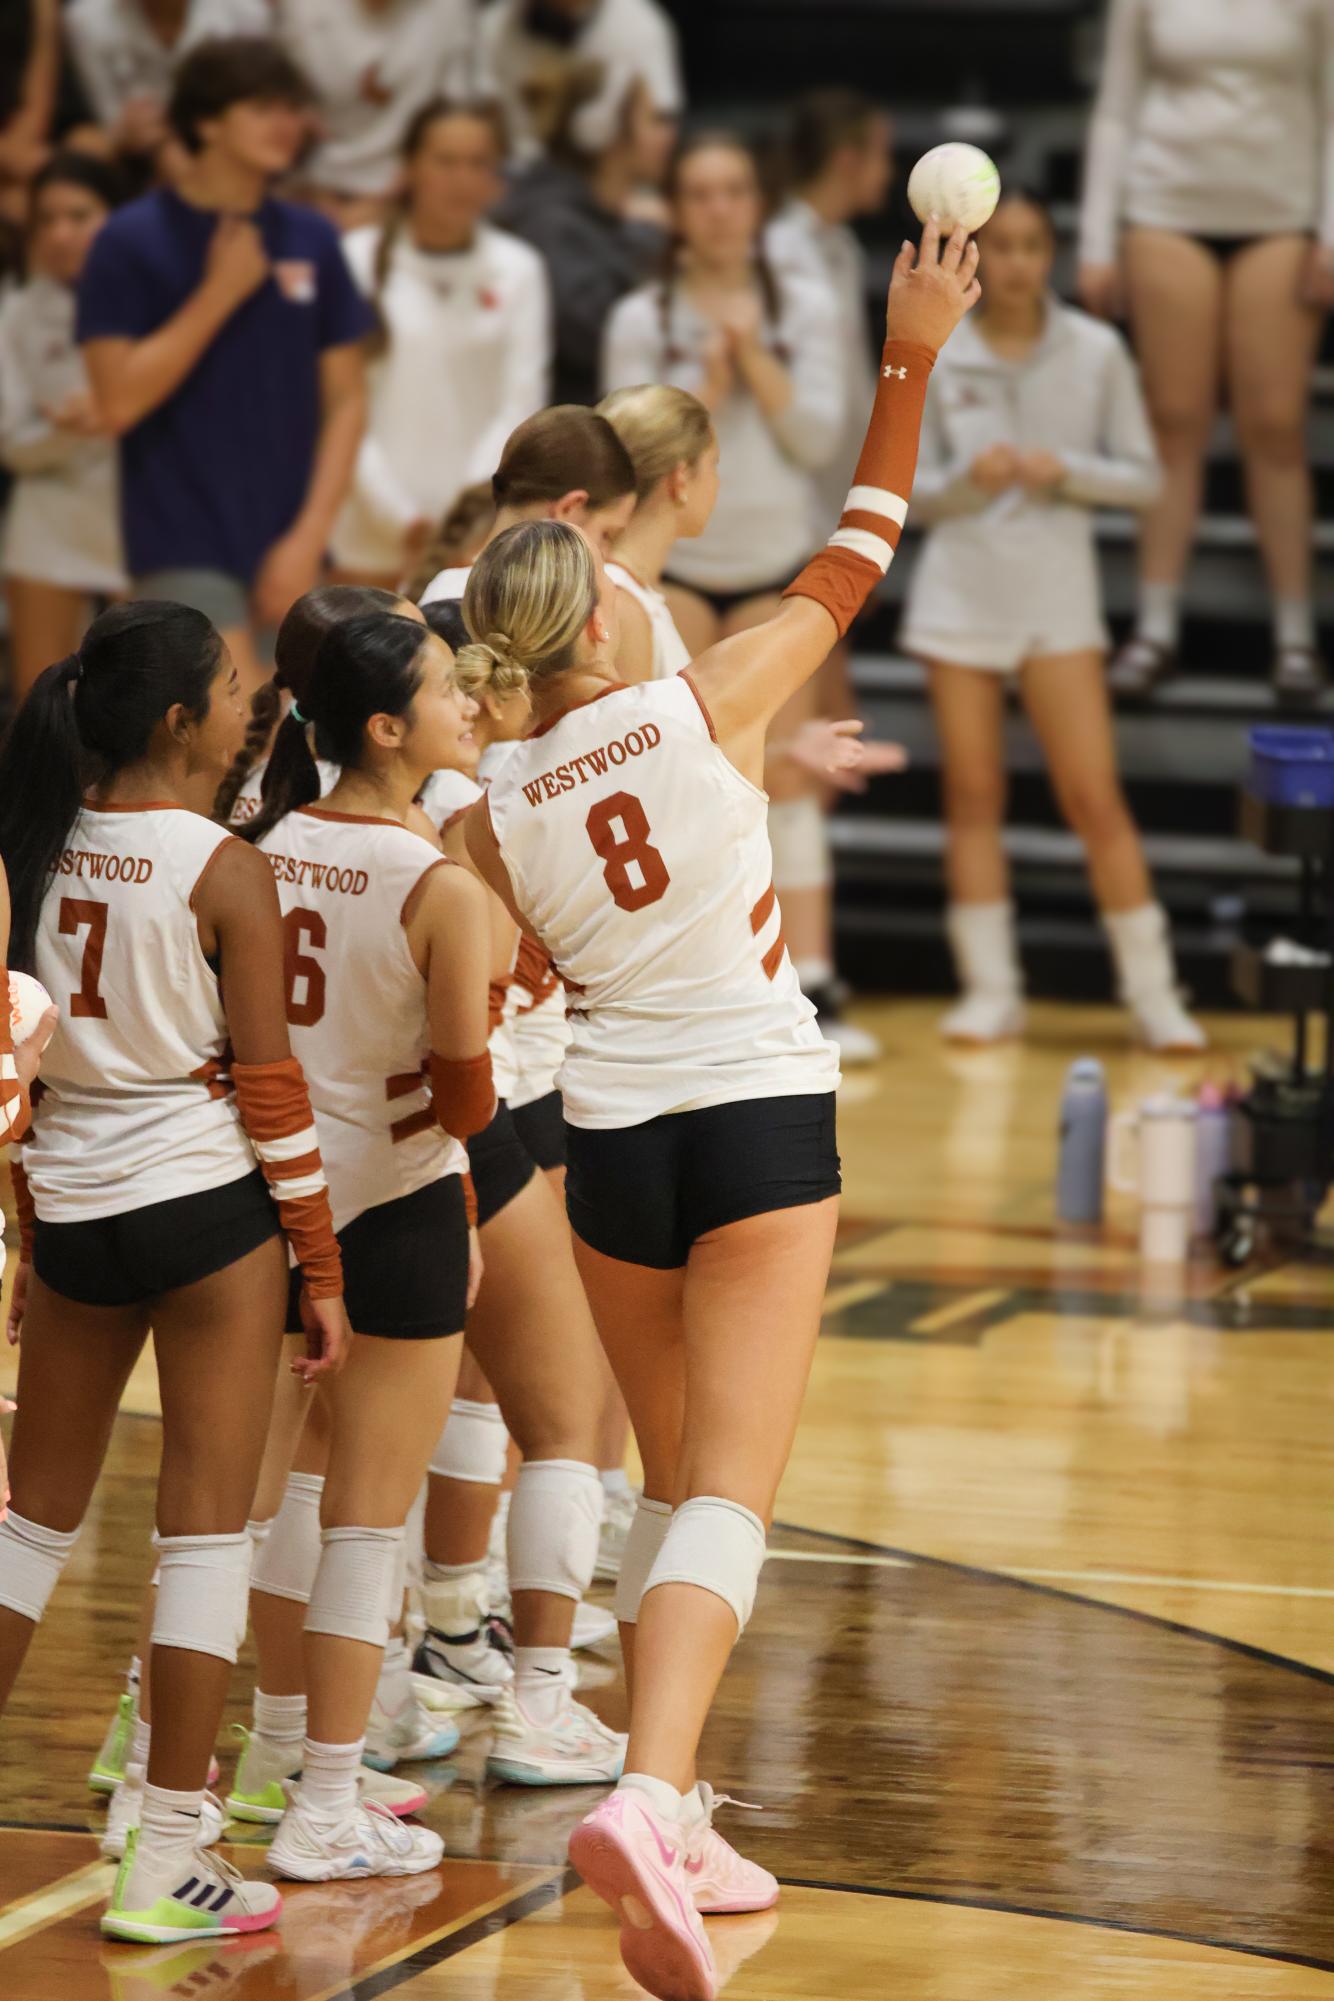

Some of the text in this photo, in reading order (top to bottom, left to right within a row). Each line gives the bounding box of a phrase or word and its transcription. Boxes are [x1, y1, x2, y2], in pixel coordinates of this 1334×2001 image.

[522, 723, 661, 808] WESTWOOD
[585, 790, 671, 913] 8
[58, 896, 109, 1020] 7
[282, 906, 327, 1028] 6
